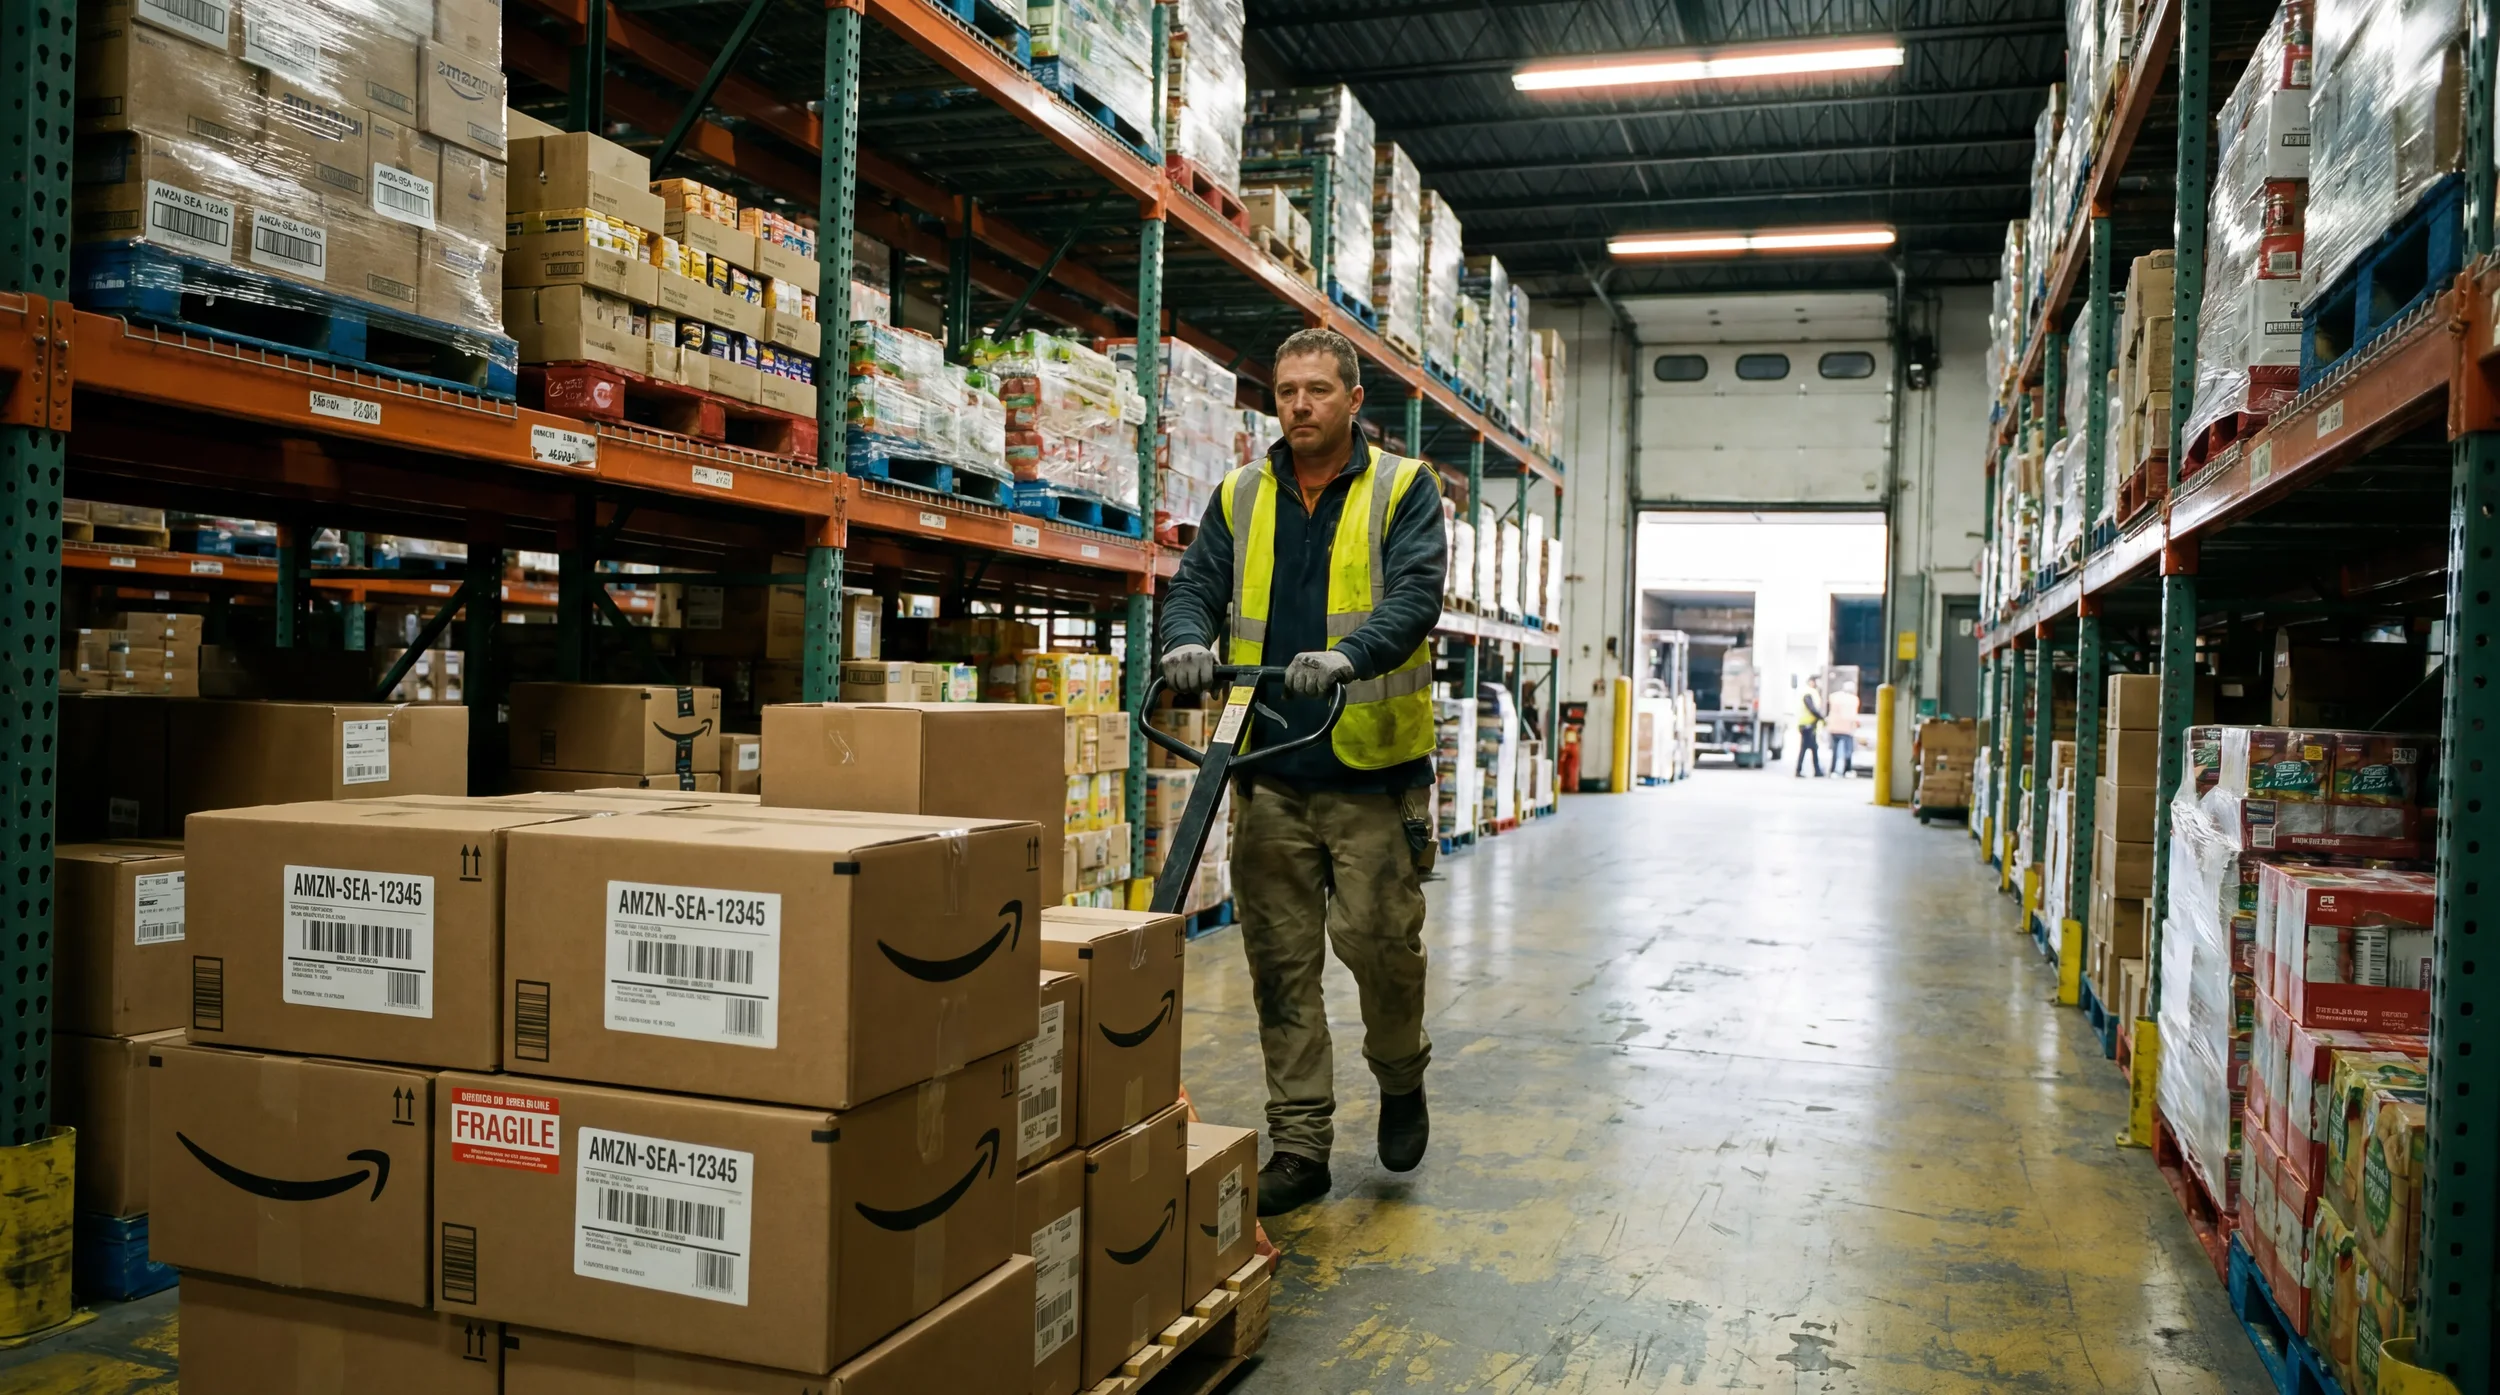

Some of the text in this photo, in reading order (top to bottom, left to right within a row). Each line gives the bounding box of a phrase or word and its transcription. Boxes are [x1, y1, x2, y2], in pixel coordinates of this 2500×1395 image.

[183, 195, 203, 210] SEA
[294, 873, 422, 906] AMZN-SEA-12345
[618, 889, 766, 927] AMZN-SEA-12345
[457, 1110, 555, 1149] FRAGILE
[589, 1136, 738, 1184] AMZN-SEA-12345
